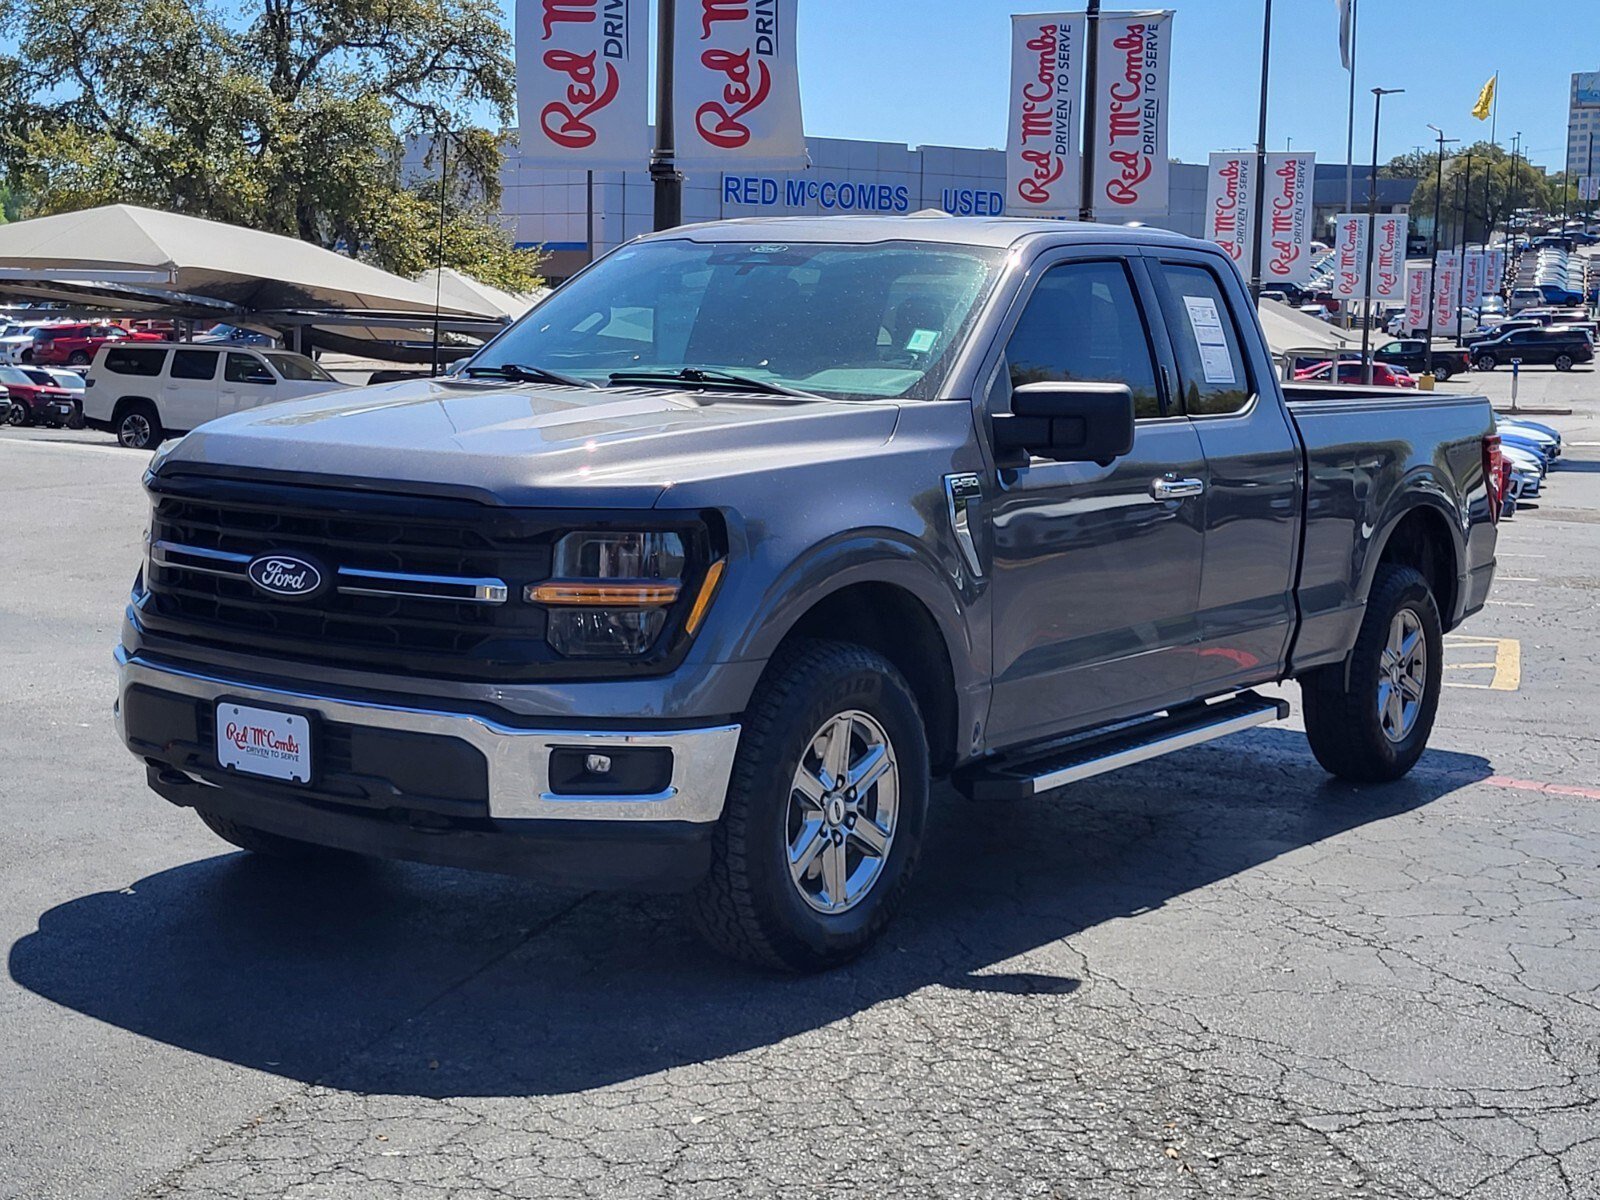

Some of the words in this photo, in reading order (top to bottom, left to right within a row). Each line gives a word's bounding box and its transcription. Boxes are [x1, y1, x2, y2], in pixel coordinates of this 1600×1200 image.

[604, 0, 623, 59] DRIV
[1058, 24, 1071, 69] SERVE
[1145, 23, 1159, 69] SERVE
[541, 49, 619, 148] Red
[695, 48, 771, 148] Red
[1021, 24, 1058, 145] McCombs
[1057, 74, 1069, 94] TO
[1109, 23, 1145, 146] McCombs
[1145, 73, 1157, 93] TO
[1055, 99, 1068, 155] DRIVEN
[1143, 99, 1155, 155] DRIVEN
[1018, 150, 1064, 203] Red
[1106, 150, 1152, 204] Red
[1239, 160, 1248, 190] SERVE
[1296, 159, 1306, 189] SERVE
[724, 176, 778, 206] RED
[943, 189, 1003, 216] USED
[1214, 160, 1240, 237] McCombs
[1238, 192, 1247, 207] TO
[1272, 159, 1297, 238] McCombs
[1295, 192, 1304, 207] TO
[1236, 208, 1245, 244] DRIVEN
[1294, 208, 1303, 244] DRIVEN
[1269, 240, 1299, 275] Red
[1338, 271, 1359, 294] Red
[1377, 271, 1397, 295] Red
[261, 560, 306, 589] Ford
[226, 722, 248, 750] Red
[249, 726, 299, 754] McCombs
[246, 745, 269, 757] DRIVEN
[270, 750, 279, 758] TO
[280, 752, 300, 762] SERVE
